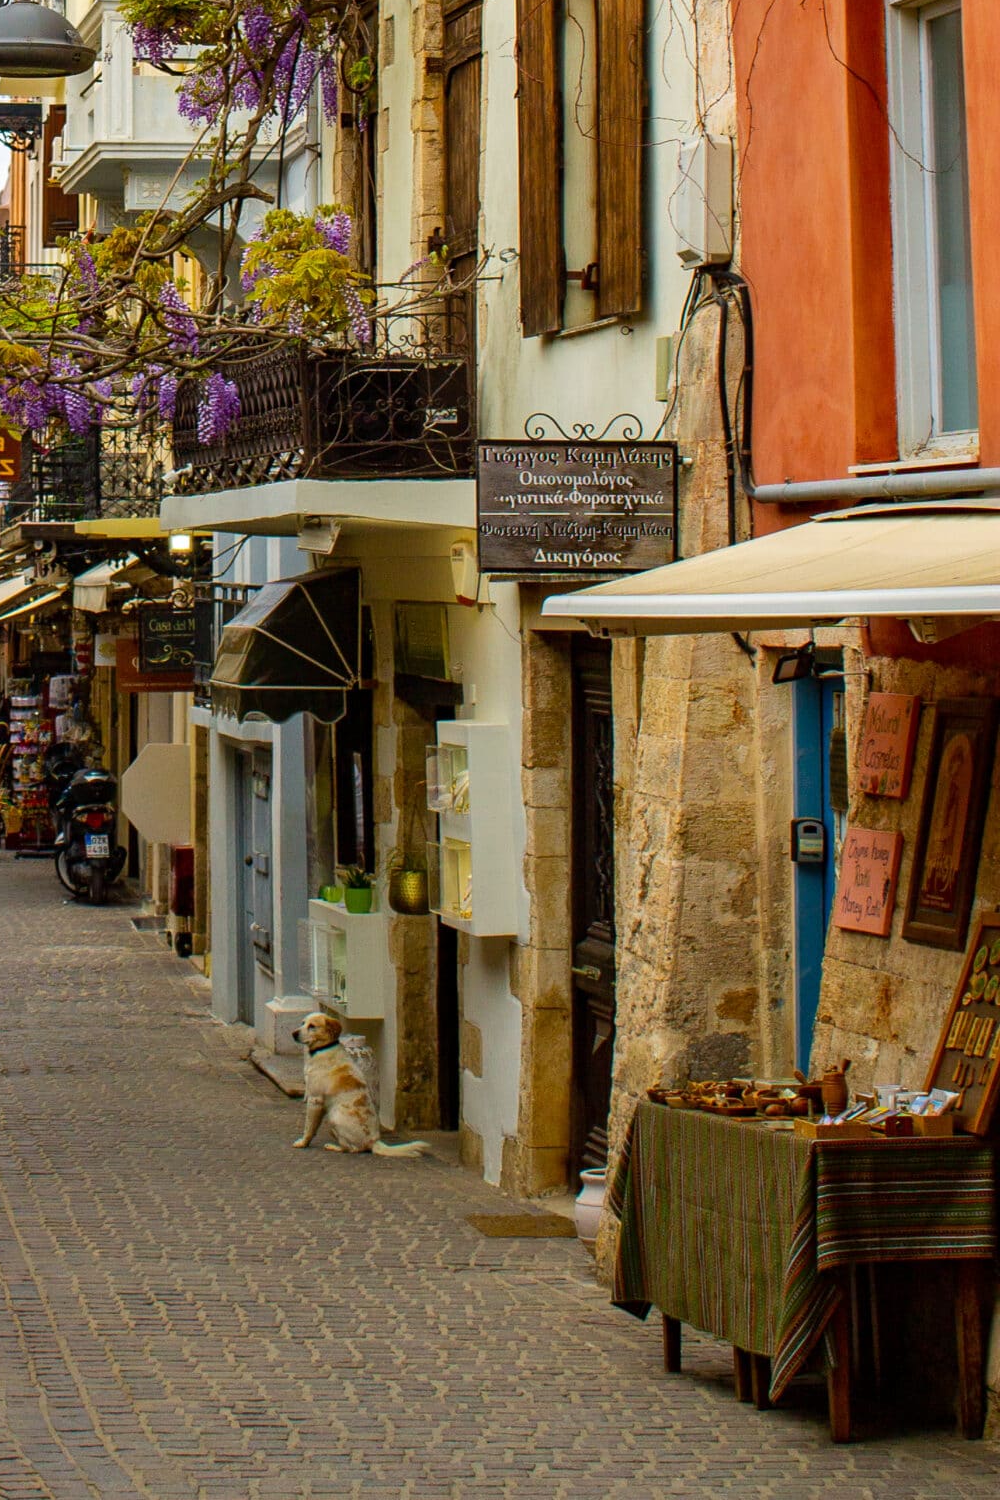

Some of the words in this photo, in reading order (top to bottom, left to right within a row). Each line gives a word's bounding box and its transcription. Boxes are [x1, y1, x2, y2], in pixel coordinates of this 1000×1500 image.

[482, 446, 560, 468] Γιώργος
[564, 447, 673, 469] Καμηλάκης
[519, 471, 633, 490] Οικονομολόγος
[492, 490, 665, 509] ογιστικά-Φοροτεχνικά
[533, 547, 622, 567] Δικηγόρος
[149, 619, 171, 633] Casa
